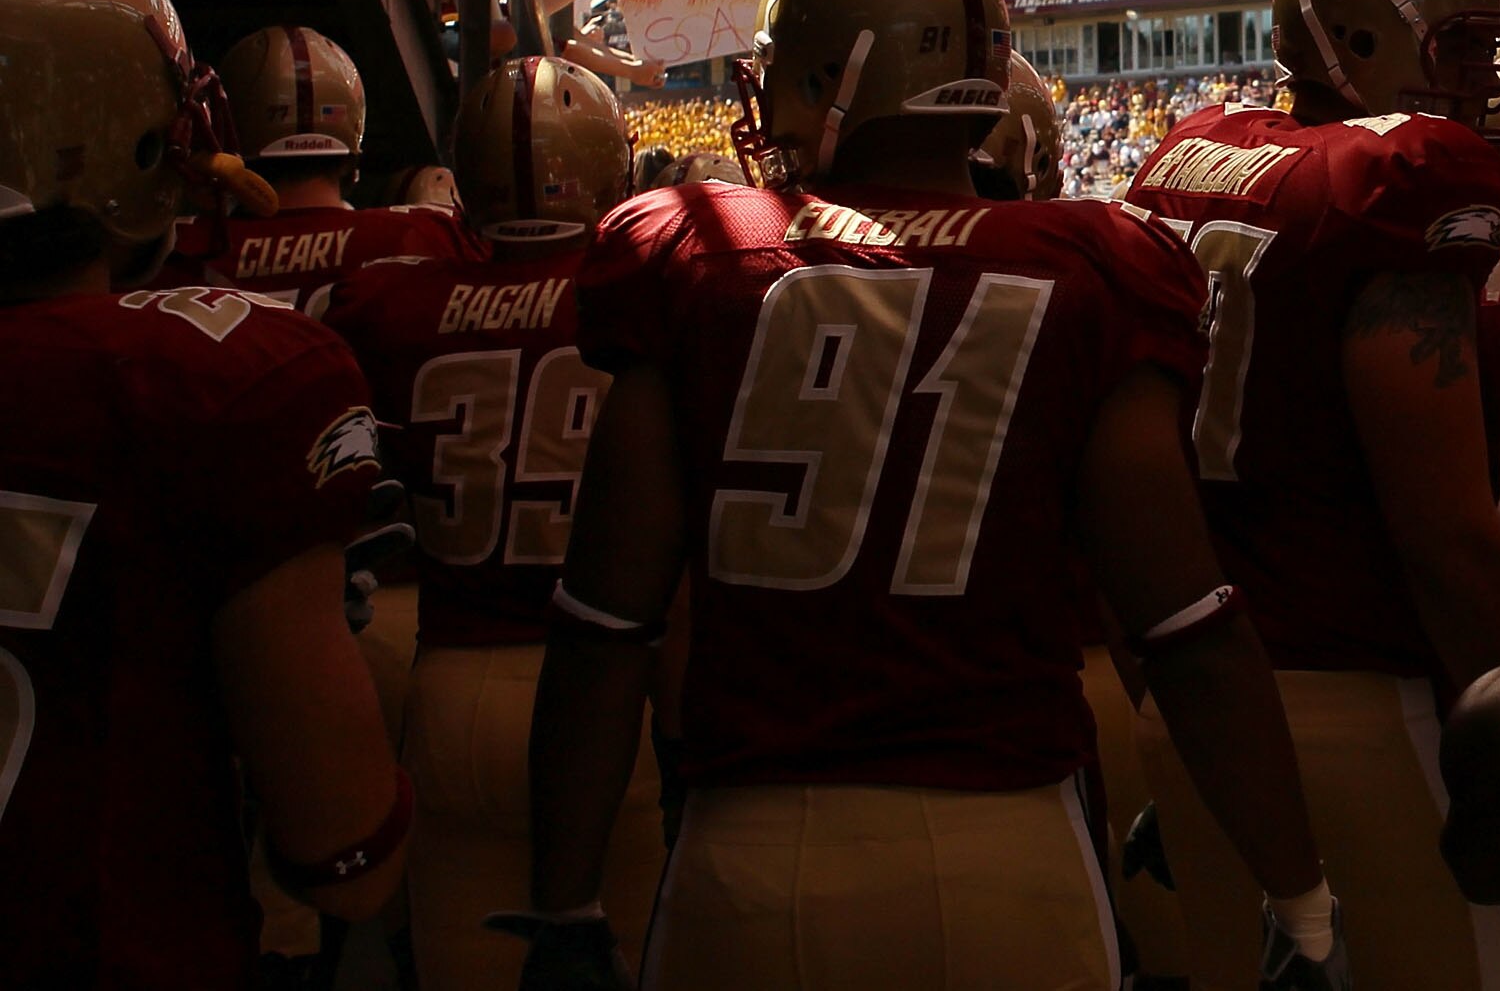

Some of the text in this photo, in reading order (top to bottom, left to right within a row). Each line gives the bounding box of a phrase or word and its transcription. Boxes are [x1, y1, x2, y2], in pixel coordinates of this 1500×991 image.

[284, 138, 333, 151] Riddell
[783, 202, 992, 247] EDEBALI
[235, 227, 354, 279] CLEARY
[437, 278, 570, 334] BAGAN
[410, 346, 616, 566] 39
[708, 264, 1056, 596] 91
